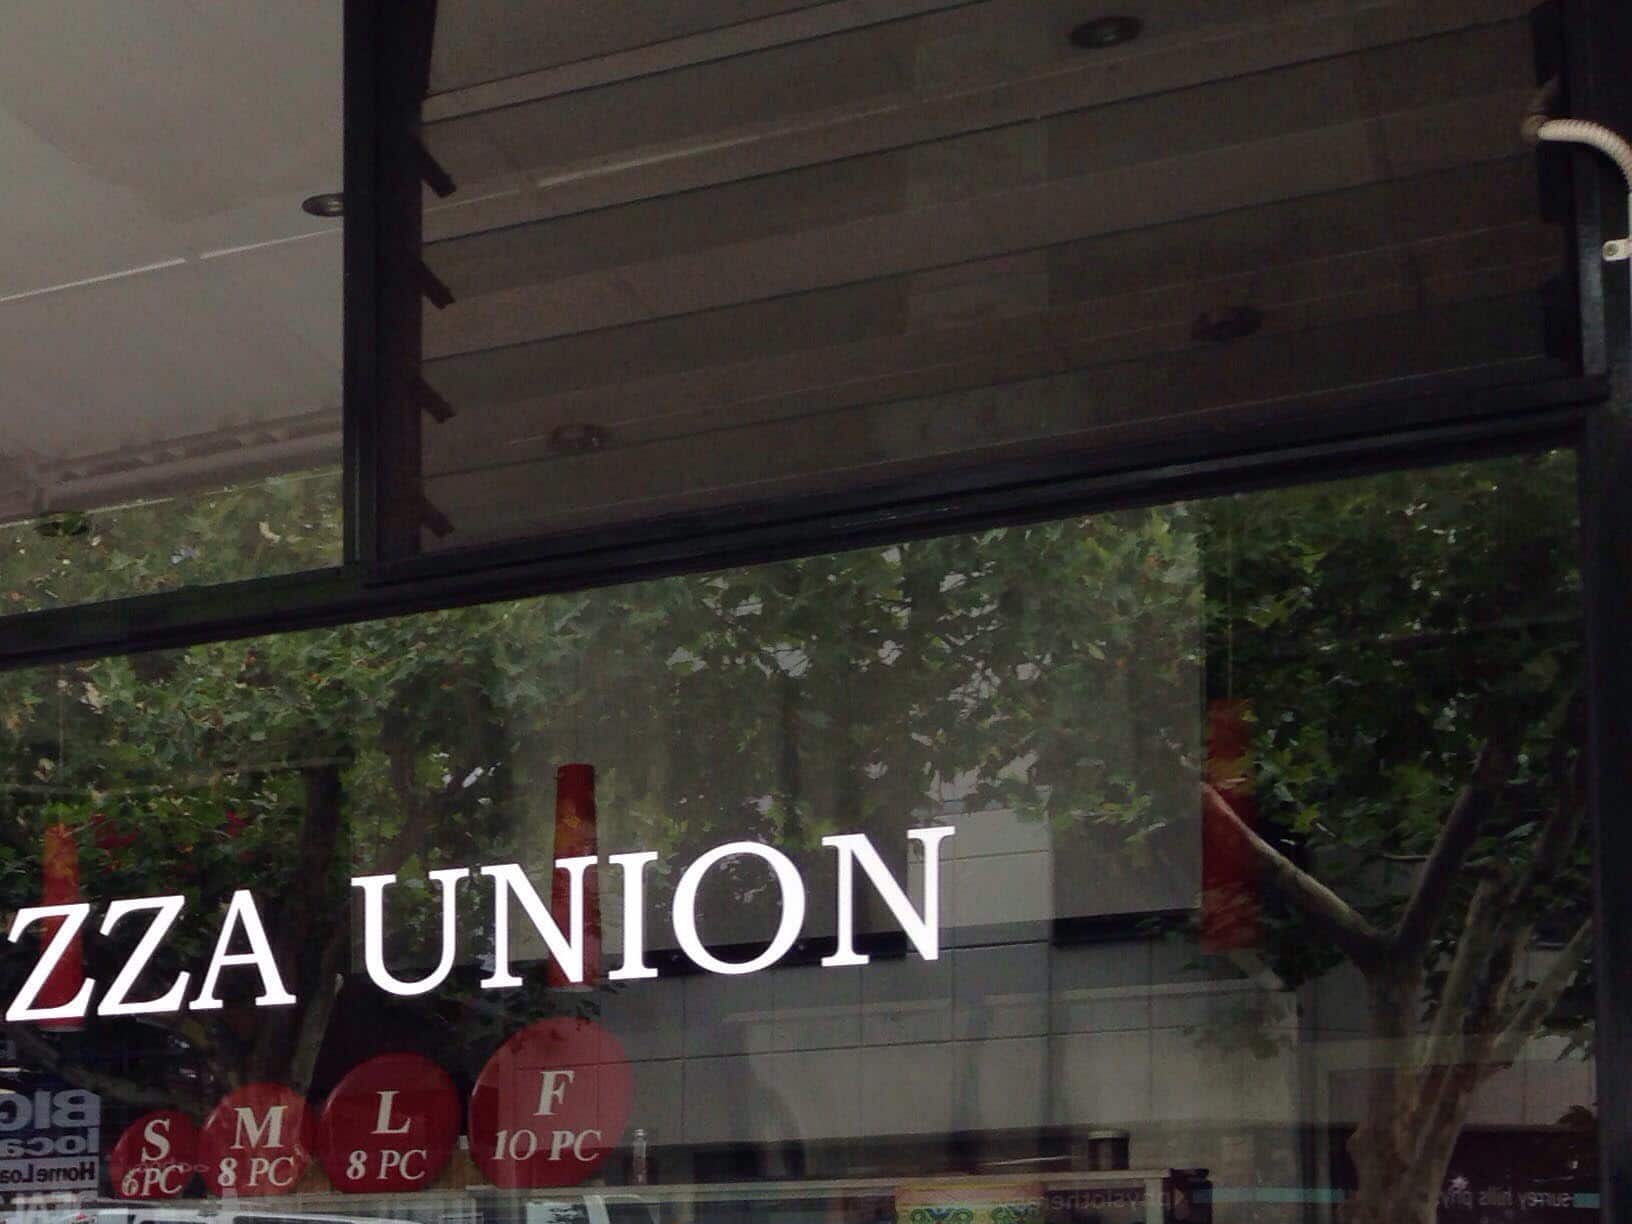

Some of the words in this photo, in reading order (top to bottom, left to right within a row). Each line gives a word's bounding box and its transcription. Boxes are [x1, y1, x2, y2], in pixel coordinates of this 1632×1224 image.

[351, 825, 955, 996] UNION
[370, 1090, 412, 1135] L
[532, 1070, 576, 1117] F
[141, 1118, 172, 1162] S
[229, 1105, 289, 1150] M
[491, 1129, 538, 1161] 10
[549, 1129, 603, 1162] PC
[218, 1157, 238, 1188] 8
[248, 1156, 295, 1187] PC
[345, 1150, 368, 1180] 8
[376, 1149, 428, 1180] PC
